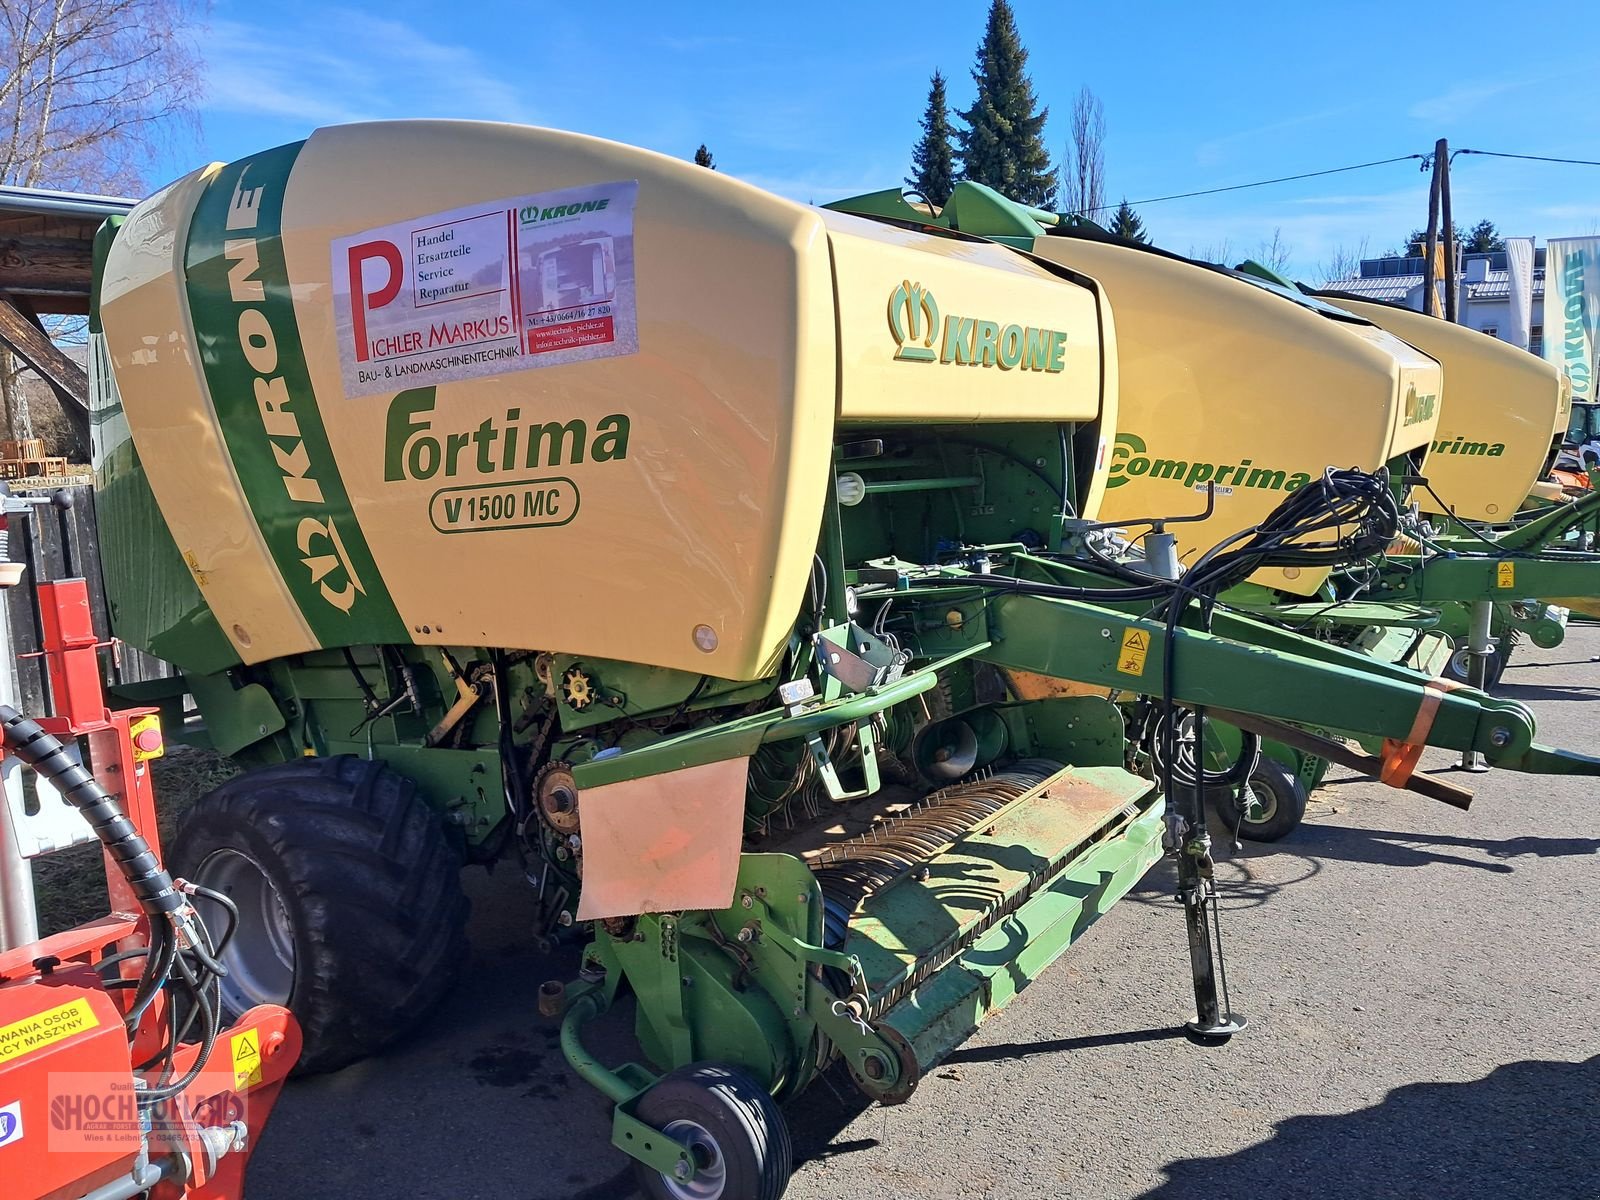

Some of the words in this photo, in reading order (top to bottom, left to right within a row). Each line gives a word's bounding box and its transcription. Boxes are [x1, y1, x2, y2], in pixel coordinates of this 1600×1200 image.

[540, 199, 611, 221] KRONE
[416, 230, 455, 248] Handel
[417, 245, 471, 266] Ersatzteile
[418, 266, 454, 282] Service
[419, 281, 470, 300] Reparatur
[528, 318, 539, 327] M:
[587, 307, 596, 316] 27
[597, 305, 611, 314] 820
[224, 163, 325, 504] KRONE
[428, 315, 509, 348] MARKUS
[940, 314, 1067, 373] KRONE
[384, 366, 392, 378] &
[395, 346, 520, 376] LANDMASCHINENTECHNIK
[384, 386, 630, 482] Fortima
[1106, 432, 1312, 492] Comprima
[444, 498, 462, 523] V
[467, 494, 516, 522] 1500
[523, 489, 560, 517] MC
[43, 1008, 79, 1026] OSÓB
[24, 1018, 83, 1046] MASZYNY
